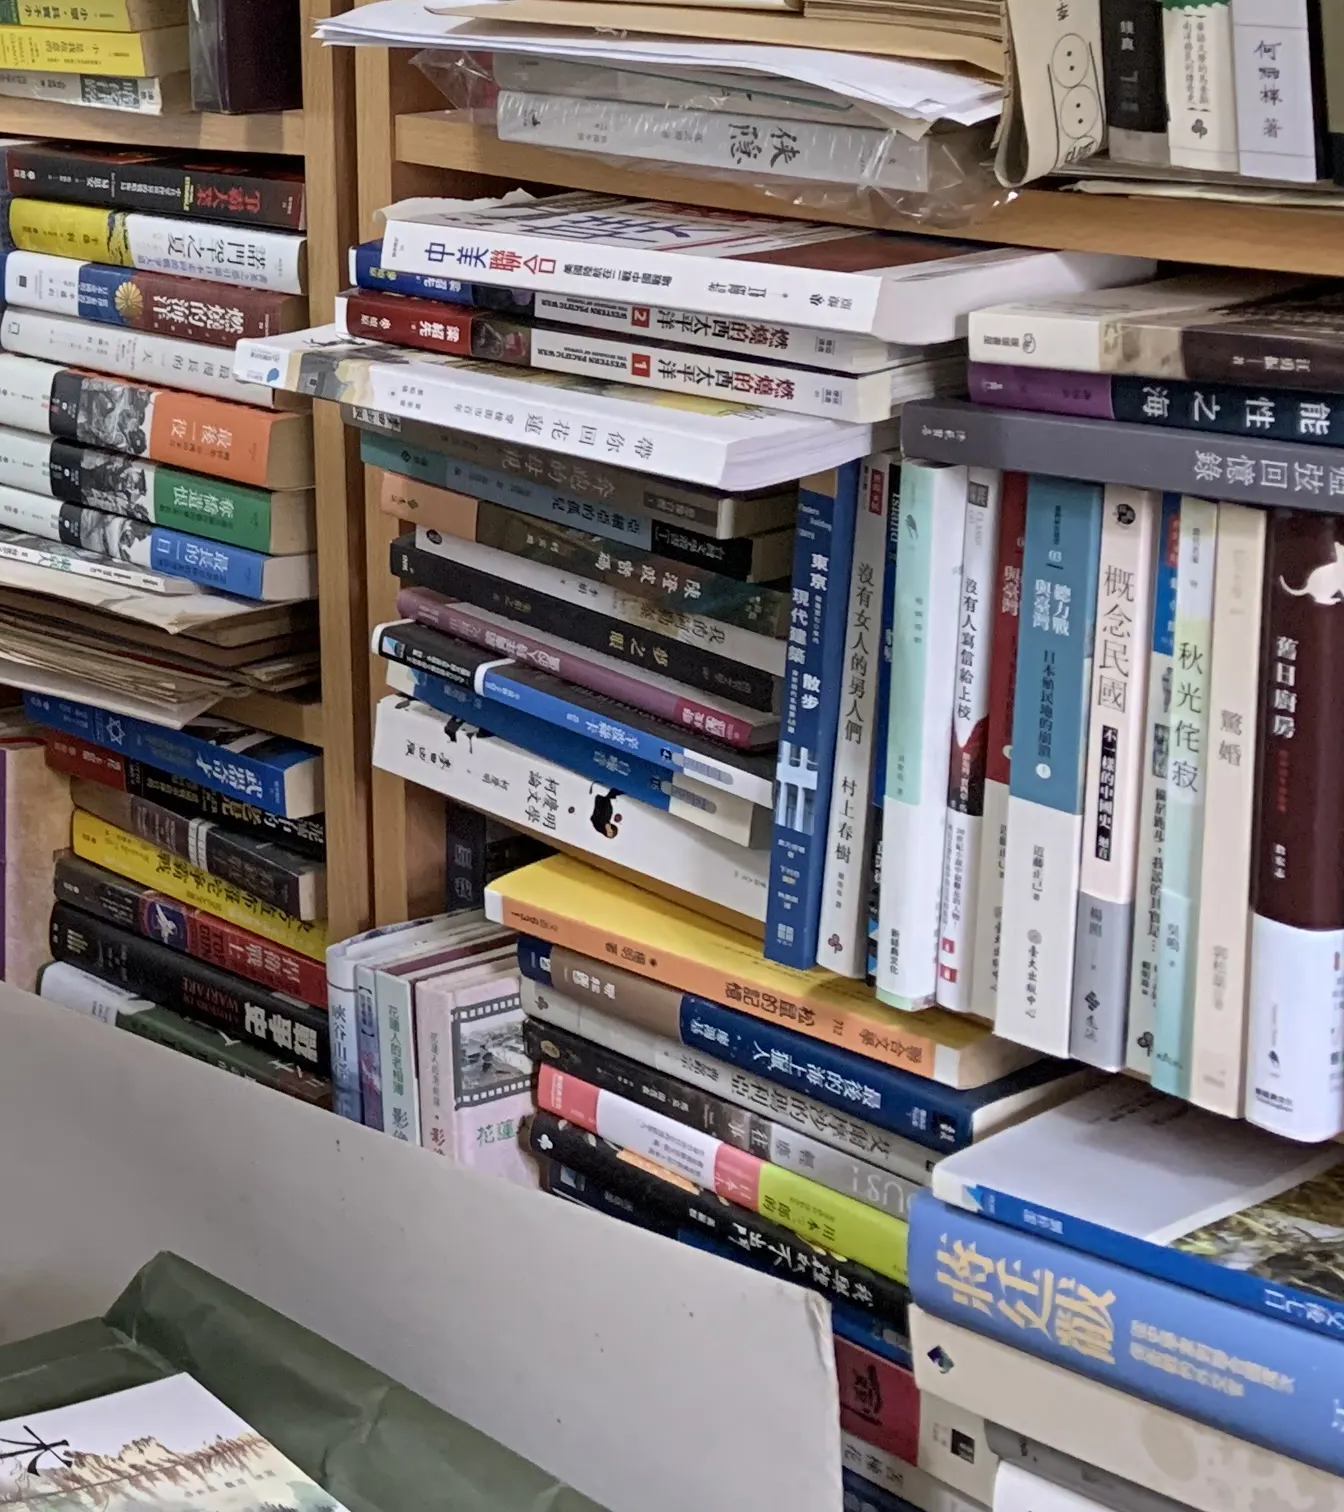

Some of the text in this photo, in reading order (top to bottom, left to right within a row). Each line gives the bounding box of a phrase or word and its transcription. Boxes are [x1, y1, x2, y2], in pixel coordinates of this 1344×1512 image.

[167, 233, 268, 268] 諾門罕之夏
[424, 243, 557, 276] 中美聯合
[152, 295, 245, 336] 燃燒的海洋
[656, 309, 790, 350] 燃燒的西太平洋
[142, 349, 230, 379] 最漫長的一天
[656, 358, 796, 401] 燃燒的西太平洋
[170, 417, 232, 450] 最後一役
[523, 409, 656, 461] 帶你回花蓮
[1140, 386, 1331, 437] 能性之海
[173, 485, 235, 519] 奪橋遺恨
[156, 537, 229, 571] 最長的一日
[594, 550, 701, 600] 陳澄波密碼
[810, 552, 830, 591] 東京
[787, 587, 811, 664] 現代建築
[957, 576, 980, 723] 沒有人寫信給上校
[1096, 562, 1136, 716] 概念民國
[844, 561, 875, 746] 沒有女人的男人們
[1271, 635, 1300, 739] 舊日廚房
[1170, 639, 1204, 795] 秋光侘寂
[541, 776, 560, 831] 柯慶明
[834, 774, 859, 865] 村上春樹
[227, 940, 301, 983] 捍衛戰士
[724, 980, 817, 1028] 松鼠的記憶
[244, 1001, 319, 1064] 戰爭史
[757, 1040, 883, 1112] 最後的海上獵人
